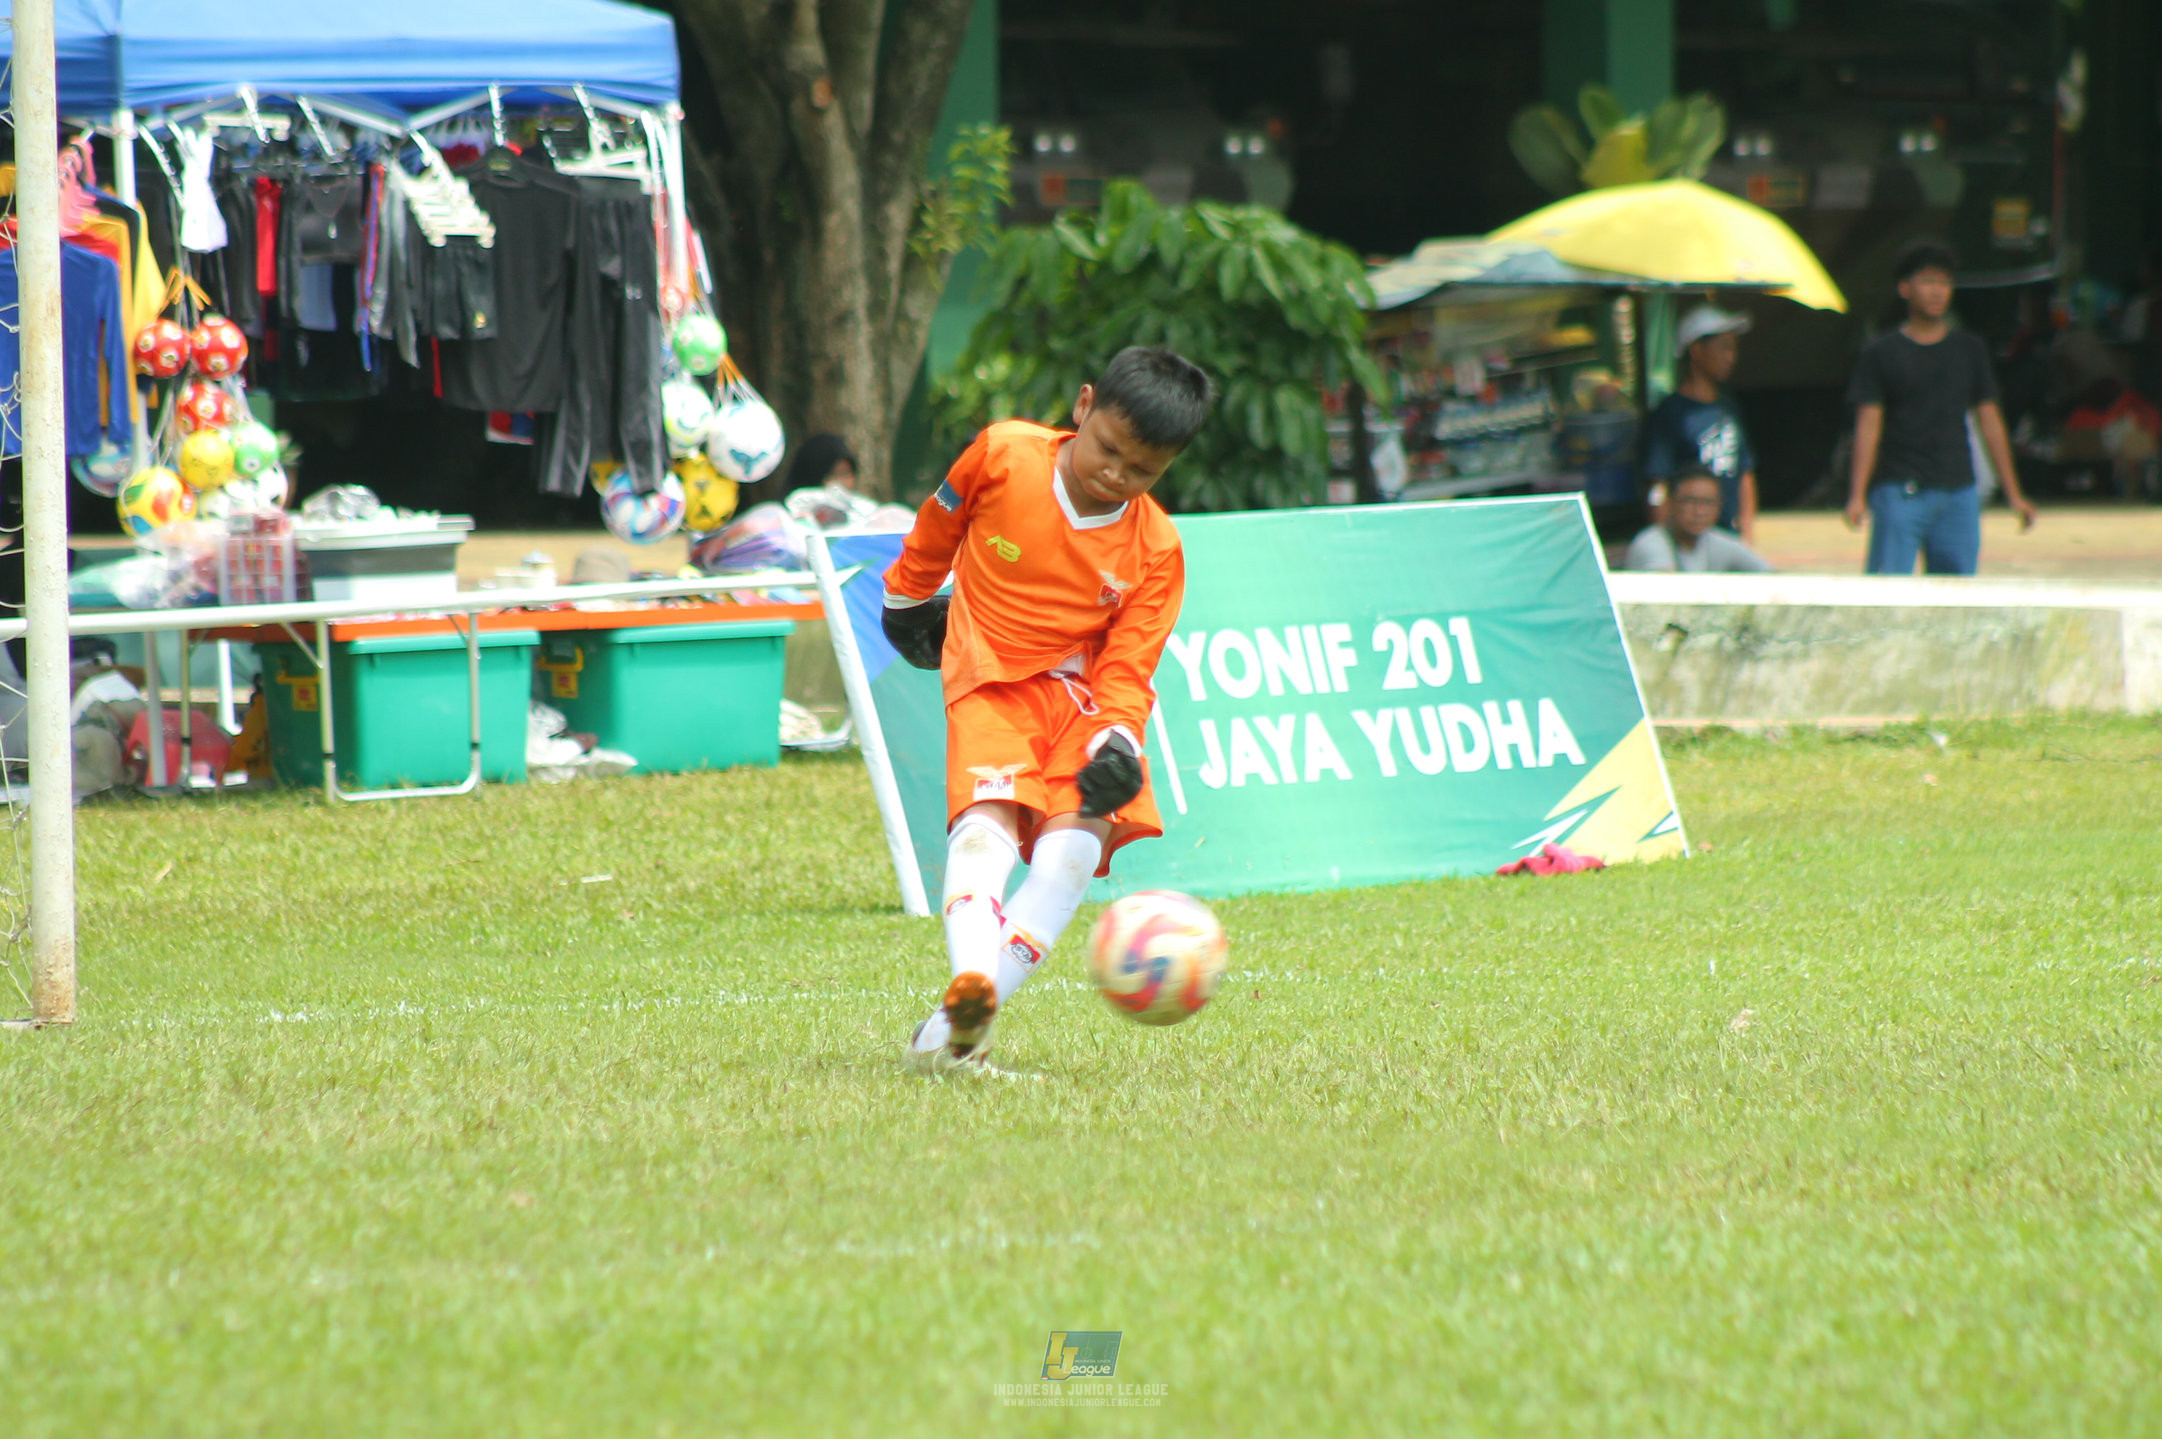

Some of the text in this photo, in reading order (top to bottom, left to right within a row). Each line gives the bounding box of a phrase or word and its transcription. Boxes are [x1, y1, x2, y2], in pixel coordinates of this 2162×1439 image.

[1167, 617, 1482, 701] YONIF 201
[1199, 698, 1585, 788] JAYA YUDHA
